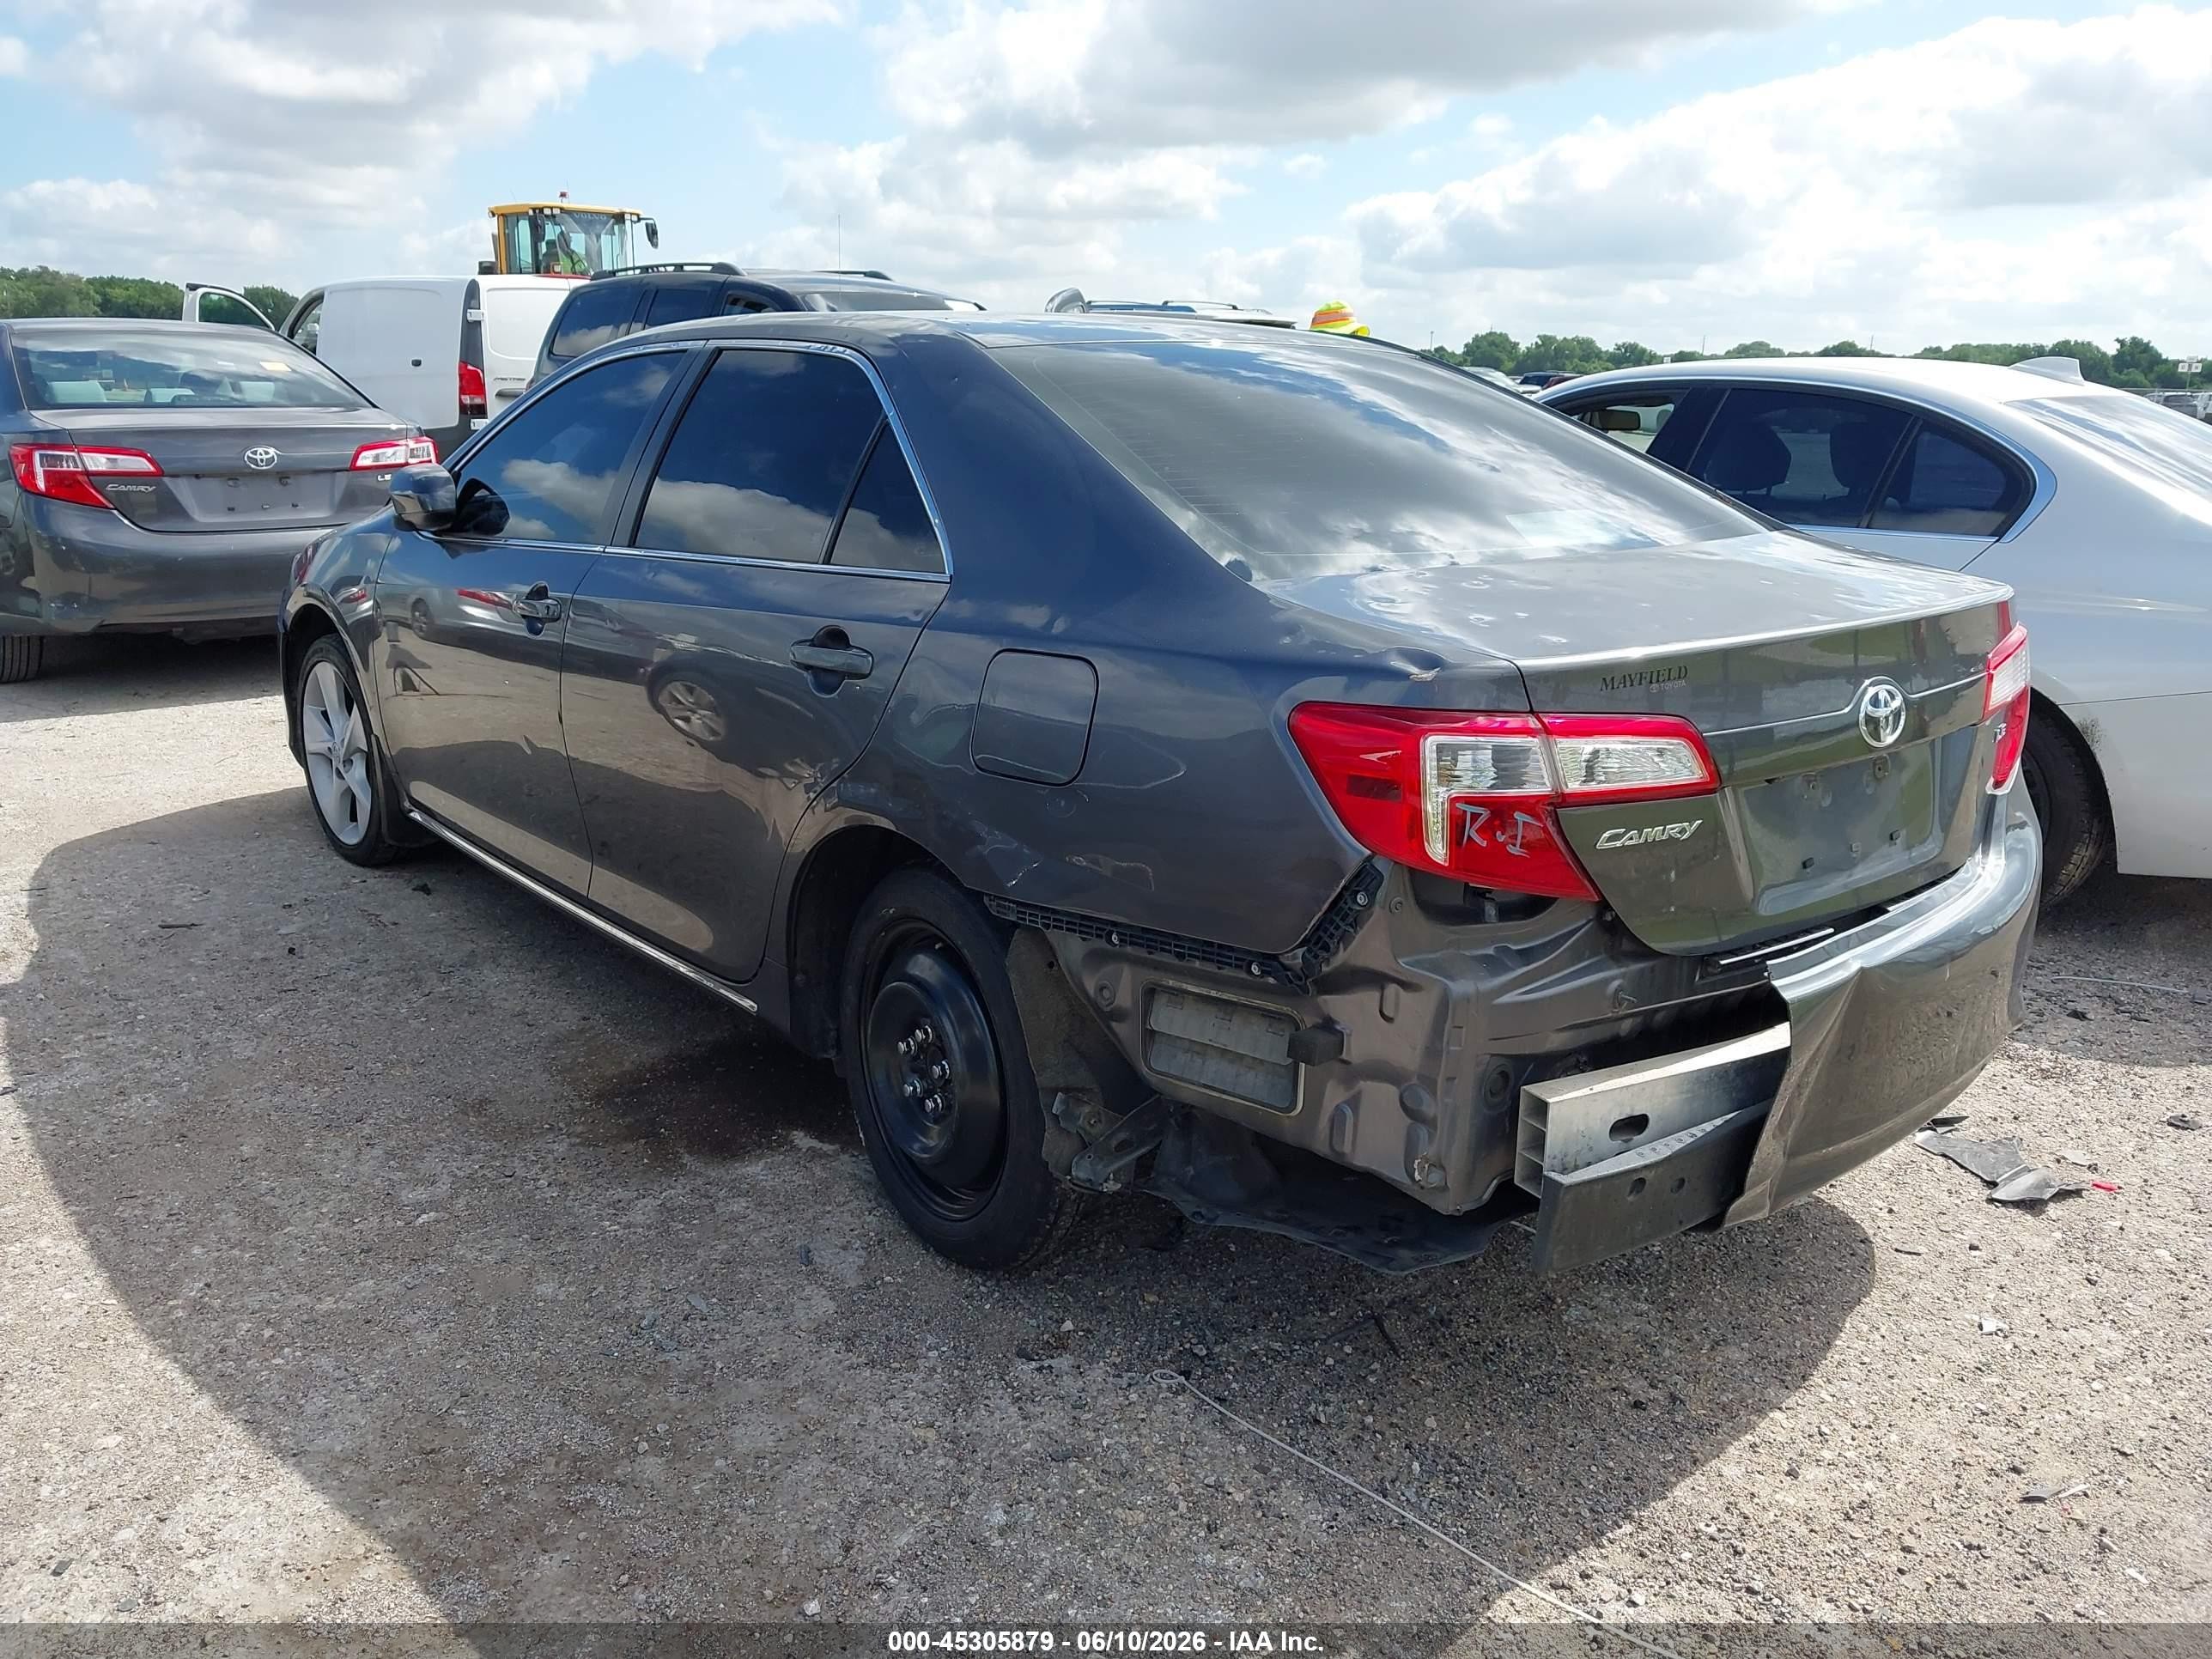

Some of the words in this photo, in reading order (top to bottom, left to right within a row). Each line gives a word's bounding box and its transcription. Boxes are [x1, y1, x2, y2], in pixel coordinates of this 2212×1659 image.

[106, 483, 156, 493] CAMRY
[1600, 665, 1688, 691] MAYFIELD
[1660, 679, 1686, 690] TOYOTA
[1595, 819, 1704, 849] CAMRY
